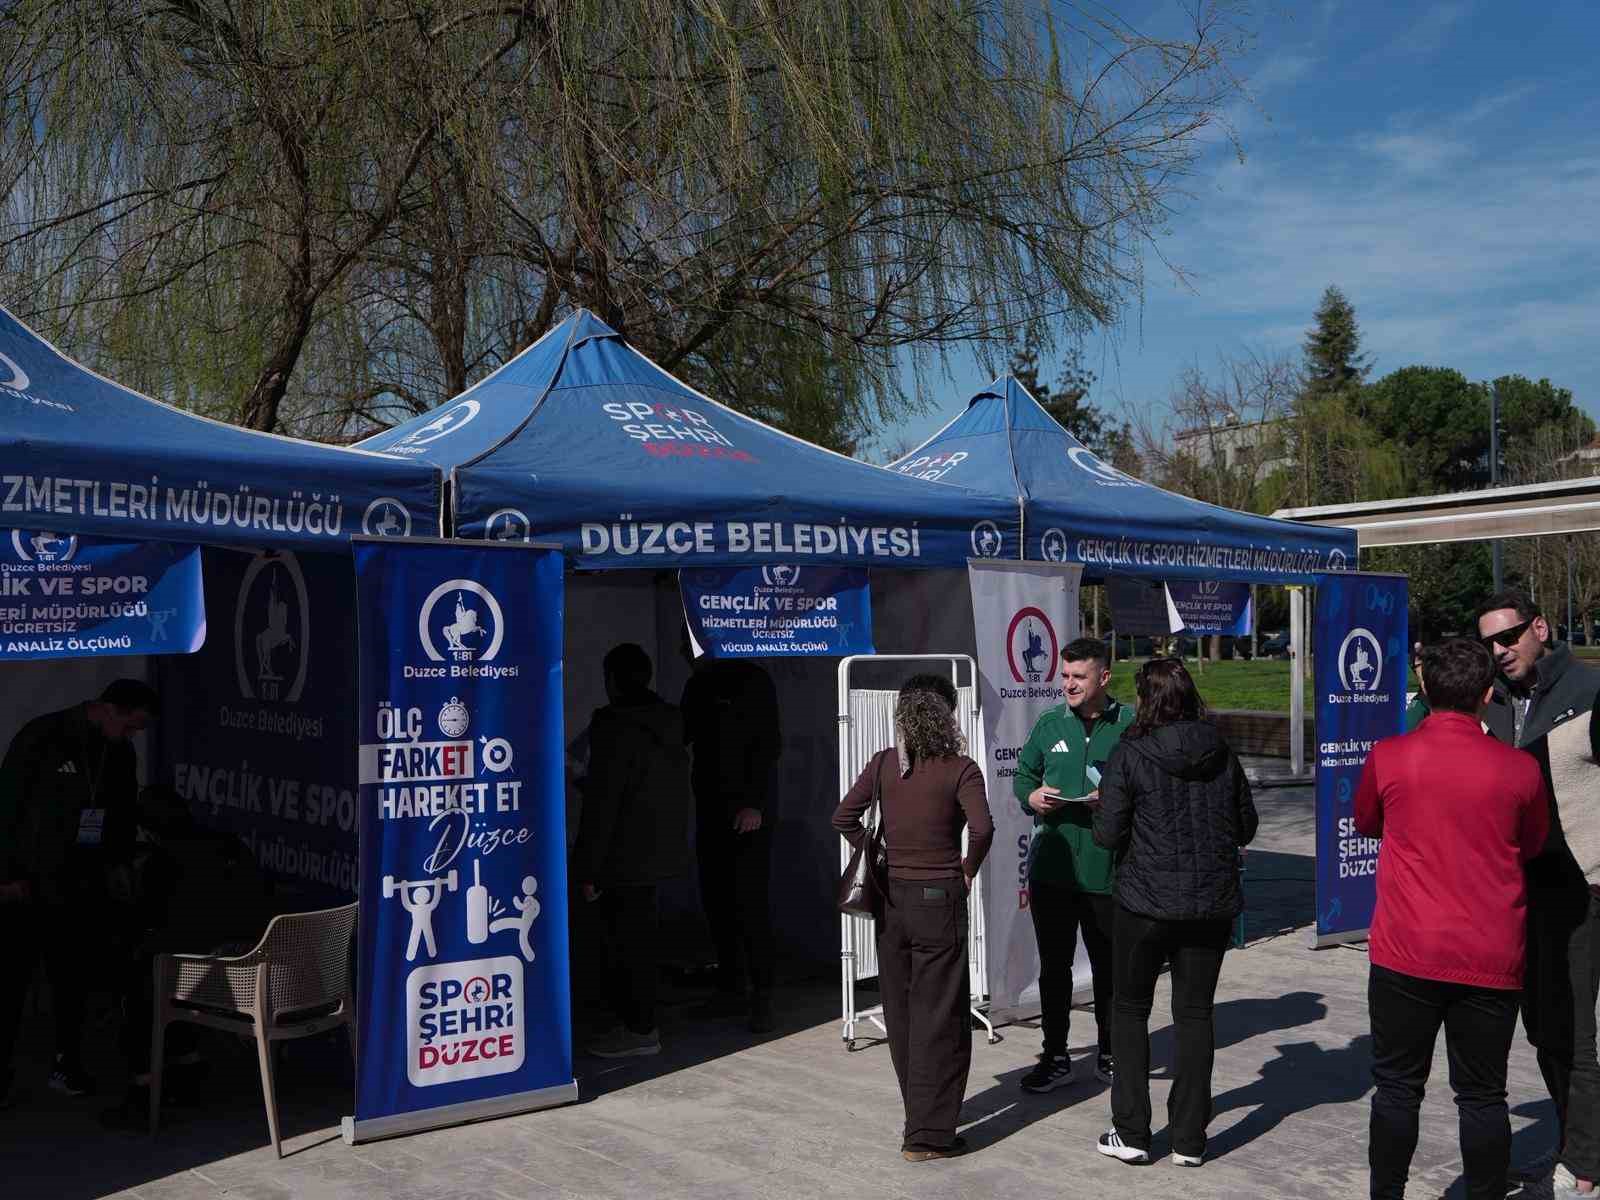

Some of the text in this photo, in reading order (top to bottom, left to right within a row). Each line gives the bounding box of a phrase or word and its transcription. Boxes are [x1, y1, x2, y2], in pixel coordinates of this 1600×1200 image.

[2, 474, 343, 536] ZMETLERİ MÜDÜRLÜĞÜ
[581, 513, 921, 557] DÜZCE BELEDİYESİ
[1077, 536, 1132, 569] GENÇLİK
[1135, 543, 1150, 565] VE
[1152, 544, 1184, 566] SPOR
[1187, 539, 1253, 570] HİZMETLERİ
[0, 572, 148, 596] İK VE SPOR
[32, 600, 148, 620] MÜDÜRLÜĞÜ
[700, 593, 837, 614] GENÇLİK VE SPOR
[3, 619, 77, 634] ÜCRETSİZ
[702, 614, 837, 629] HİZMETLERİ MÜDÜRLÜĞÜ
[752, 629, 795, 639] ÜCRETSİZ
[7, 637, 64, 652] ANALİZ
[67, 635, 132, 653] ÖLÇÜMÜ
[721, 640, 828, 653] VÜCUD ANALİZ ÖLÇÜMÜ
[450, 665, 519, 679] Belediyesi
[1028, 687, 1065, 699] Belediye
[376, 701, 422, 743] ÖLÇ
[377, 745, 469, 780] FARKET
[304, 784, 359, 832] SPO
[377, 781, 521, 819] HAREKET ET
[423, 808, 533, 874] Düzce
[1340, 858, 1378, 878] DÜZC
[418, 973, 513, 1010] SPOR
[419, 1003, 514, 1045] ŞEHRİ
[418, 1034, 515, 1070] DÜZCE
